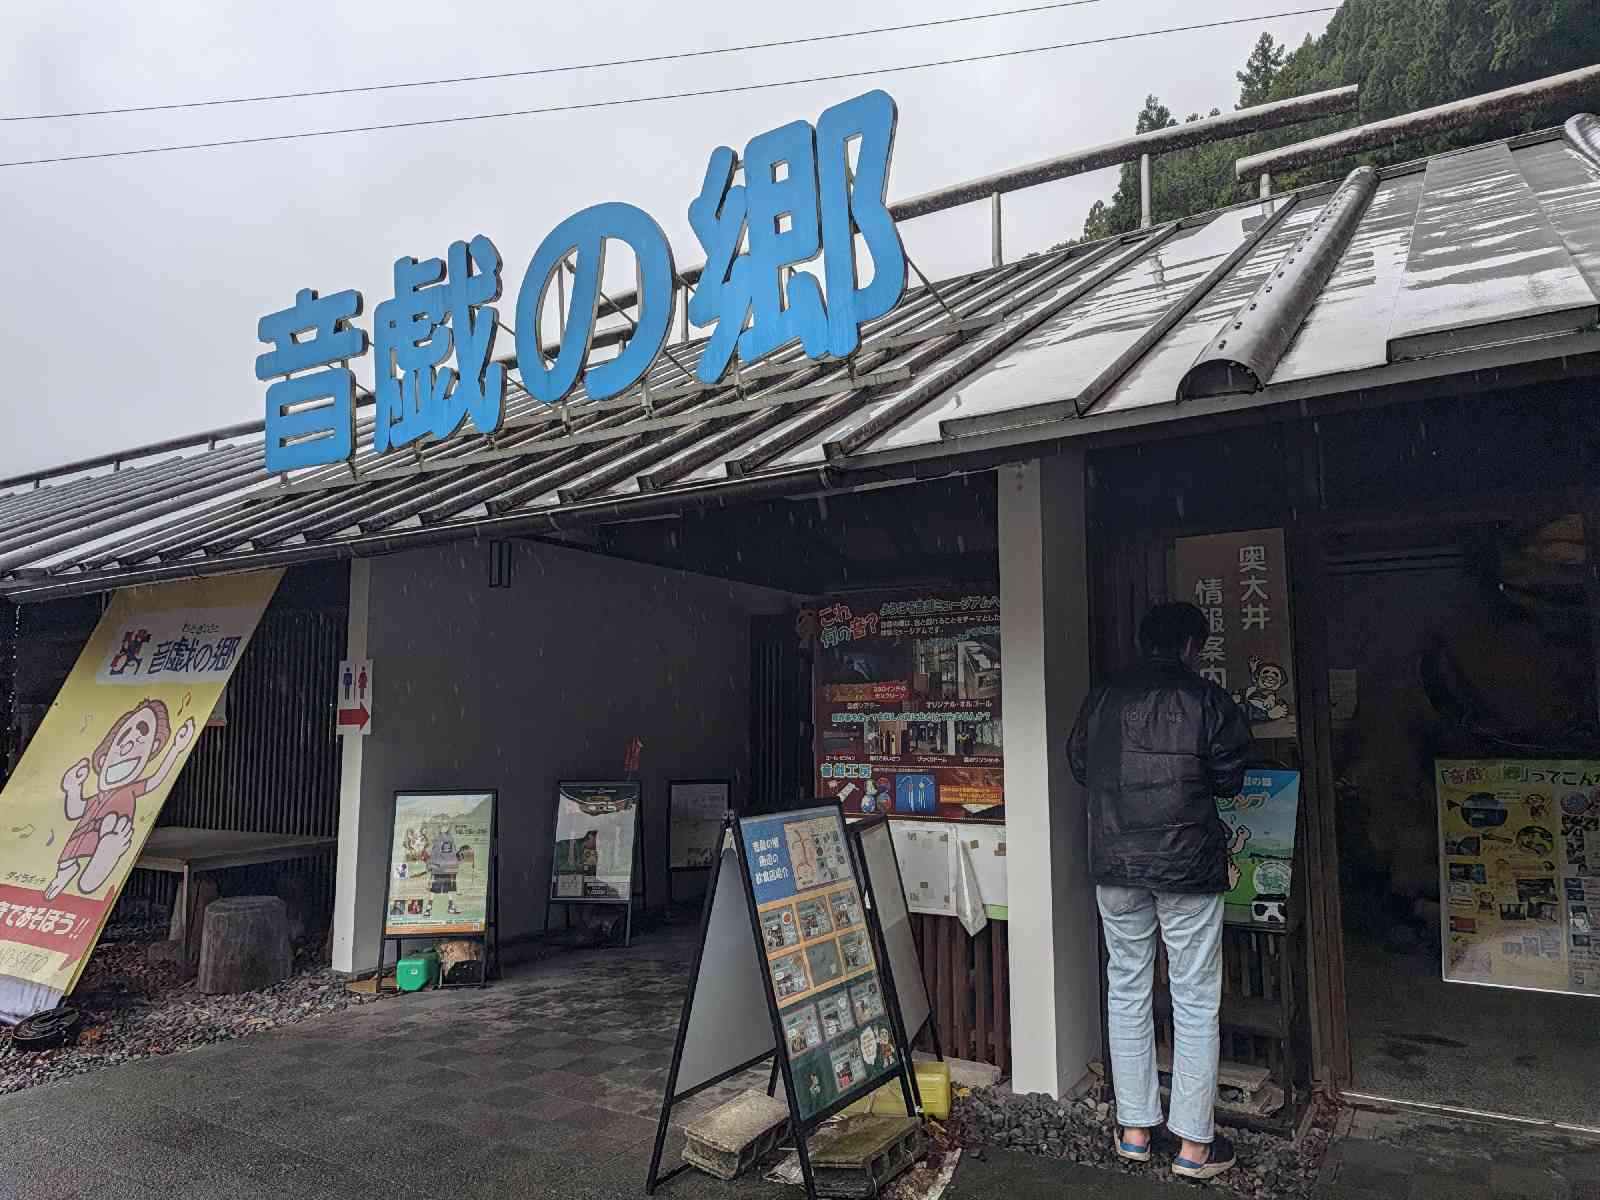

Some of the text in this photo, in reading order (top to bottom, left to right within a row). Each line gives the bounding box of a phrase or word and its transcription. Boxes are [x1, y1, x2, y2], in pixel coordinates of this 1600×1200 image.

[255, 89, 908, 474] 音戯の郷
[818, 603, 852, 627] これ
[1238, 545, 1270, 630] 奥大井
[149, 635, 242, 675] 音戯の郷
